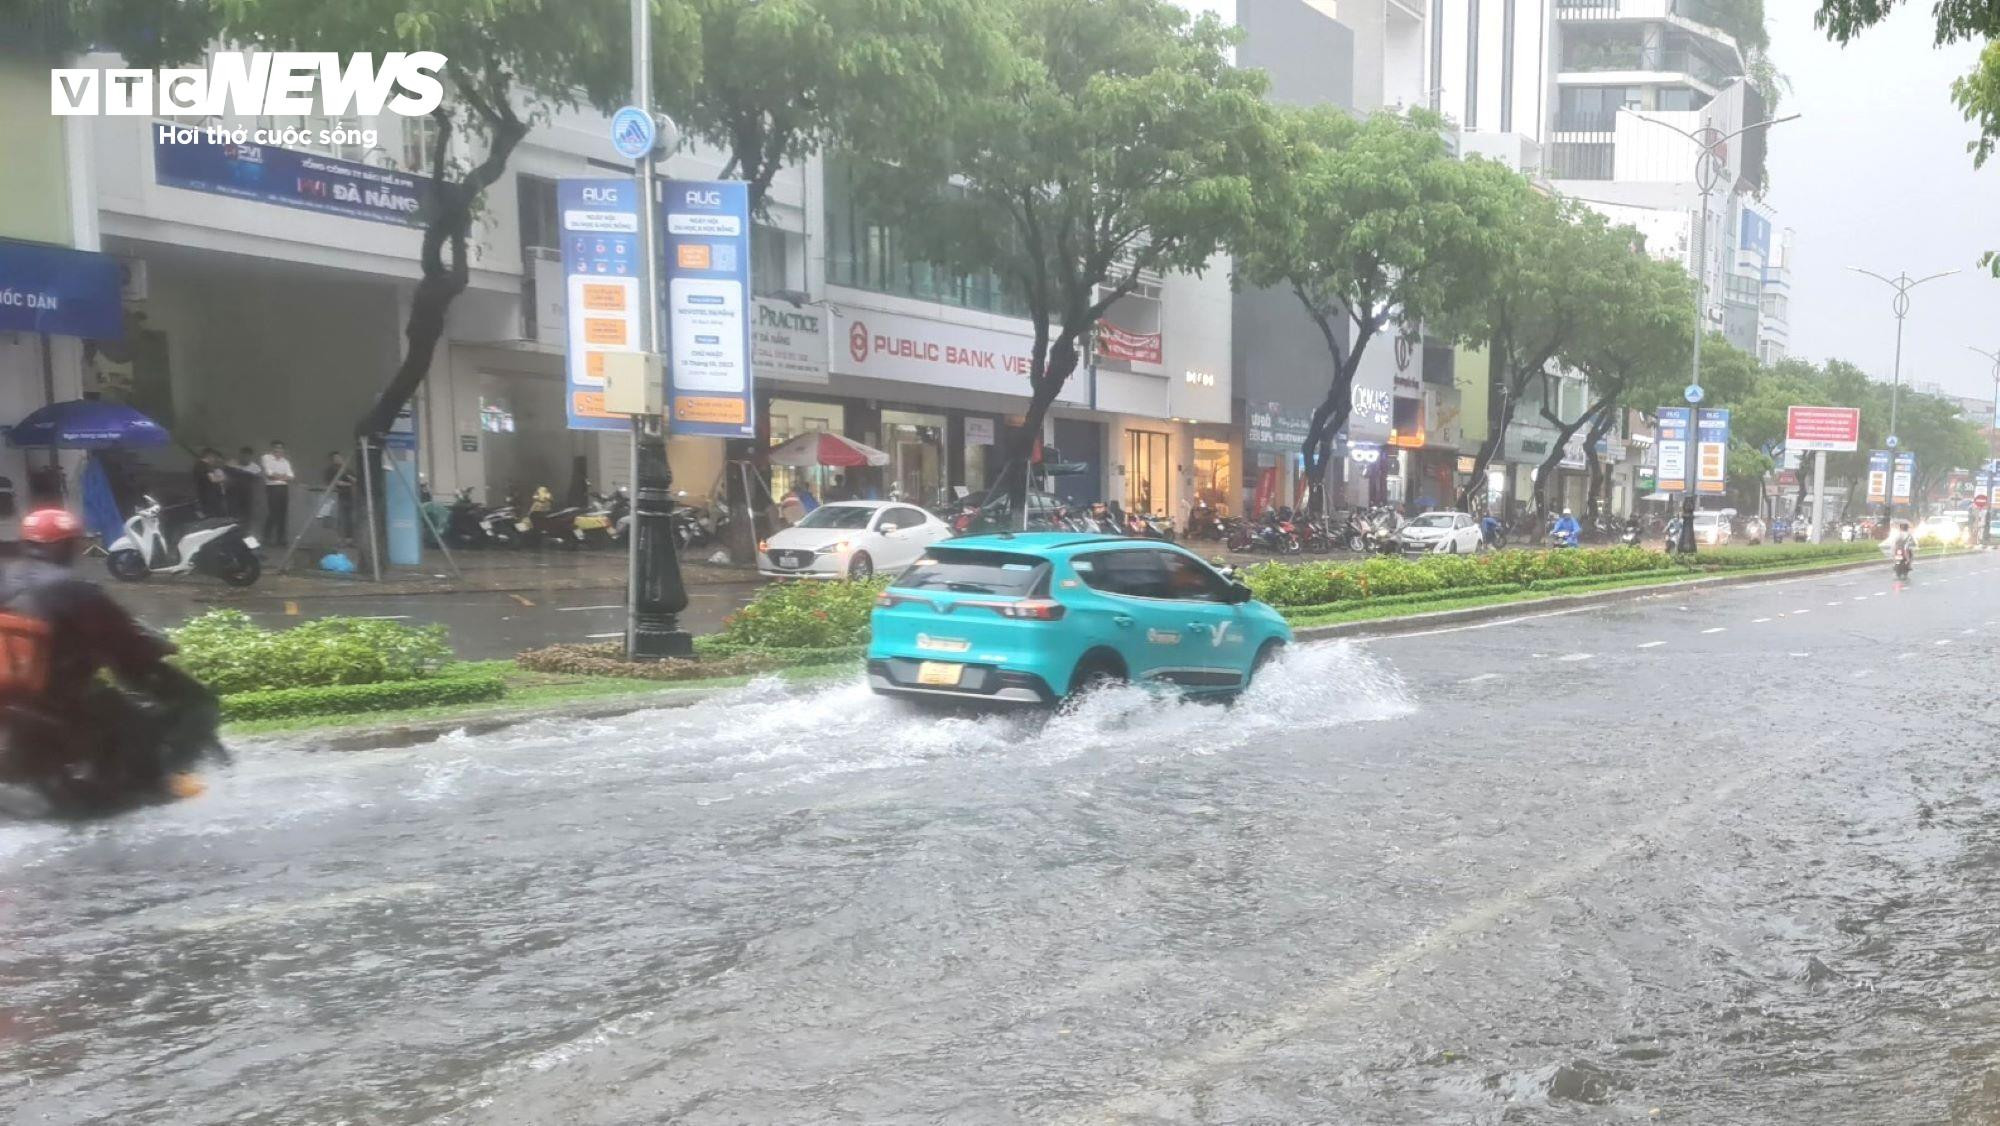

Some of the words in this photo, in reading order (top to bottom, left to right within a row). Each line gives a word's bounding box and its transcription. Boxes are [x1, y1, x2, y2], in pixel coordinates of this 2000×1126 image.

[332, 181, 362, 205] ĐÀ
[364, 185, 419, 214] NẴNG
[582, 187, 619, 202] AUG
[686, 190, 720, 205] AUG
[758, 304, 819, 334] PRACTICE
[874, 334, 940, 362] PUBLIC
[945, 345, 996, 369] BANK
